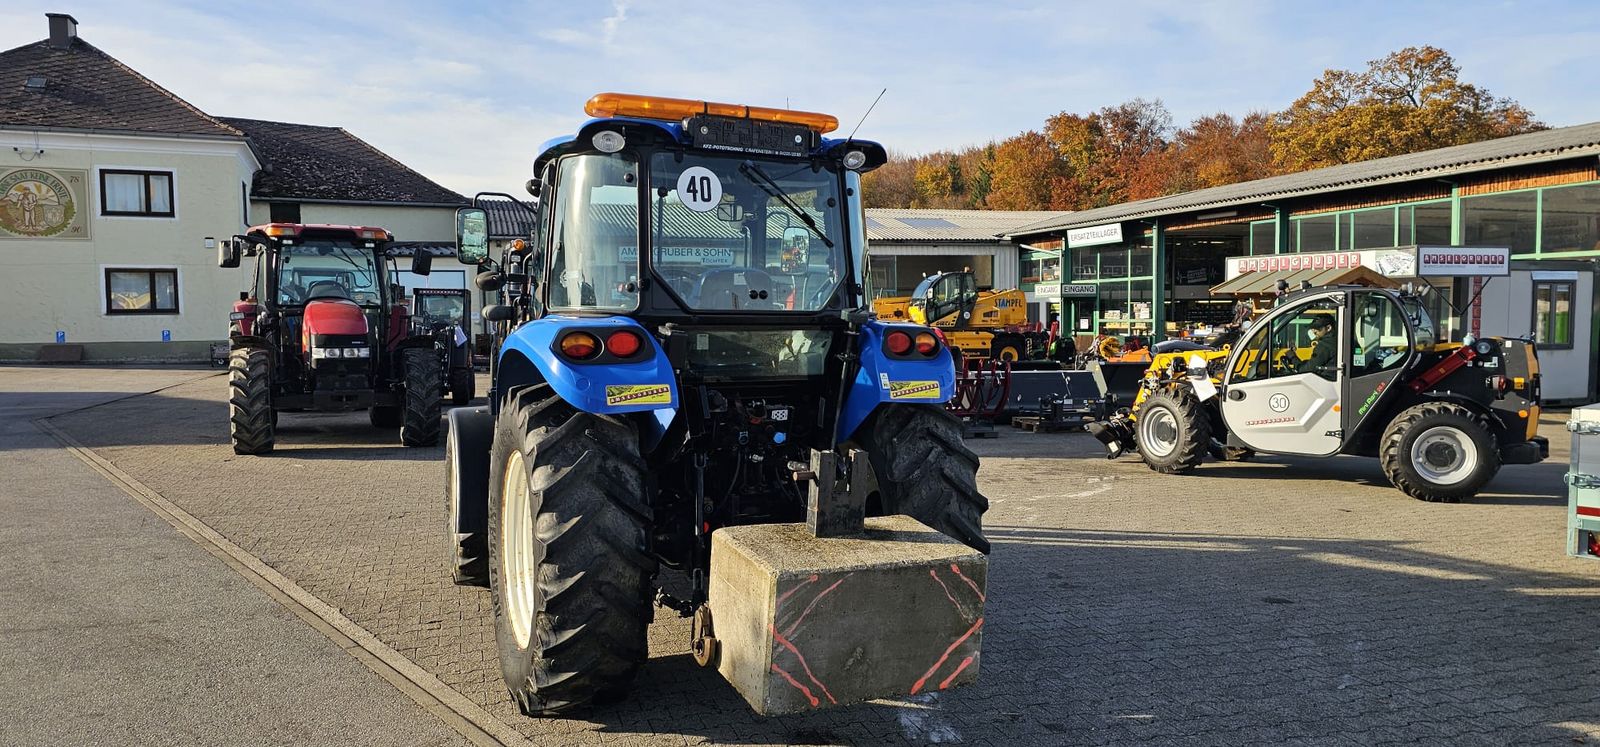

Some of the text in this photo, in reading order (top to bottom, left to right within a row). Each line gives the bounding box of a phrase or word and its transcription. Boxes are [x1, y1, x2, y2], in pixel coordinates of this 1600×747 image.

[686, 175, 712, 203] 40
[1070, 227, 1119, 242] ERSATZTEILLAGER
[694, 248, 702, 257] &
[702, 248, 731, 258] SOHN
[1239, 253, 1361, 271] AMSELGRUBER
[1063, 284, 1095, 293] EINGANG
[1272, 397, 1288, 409] 30
